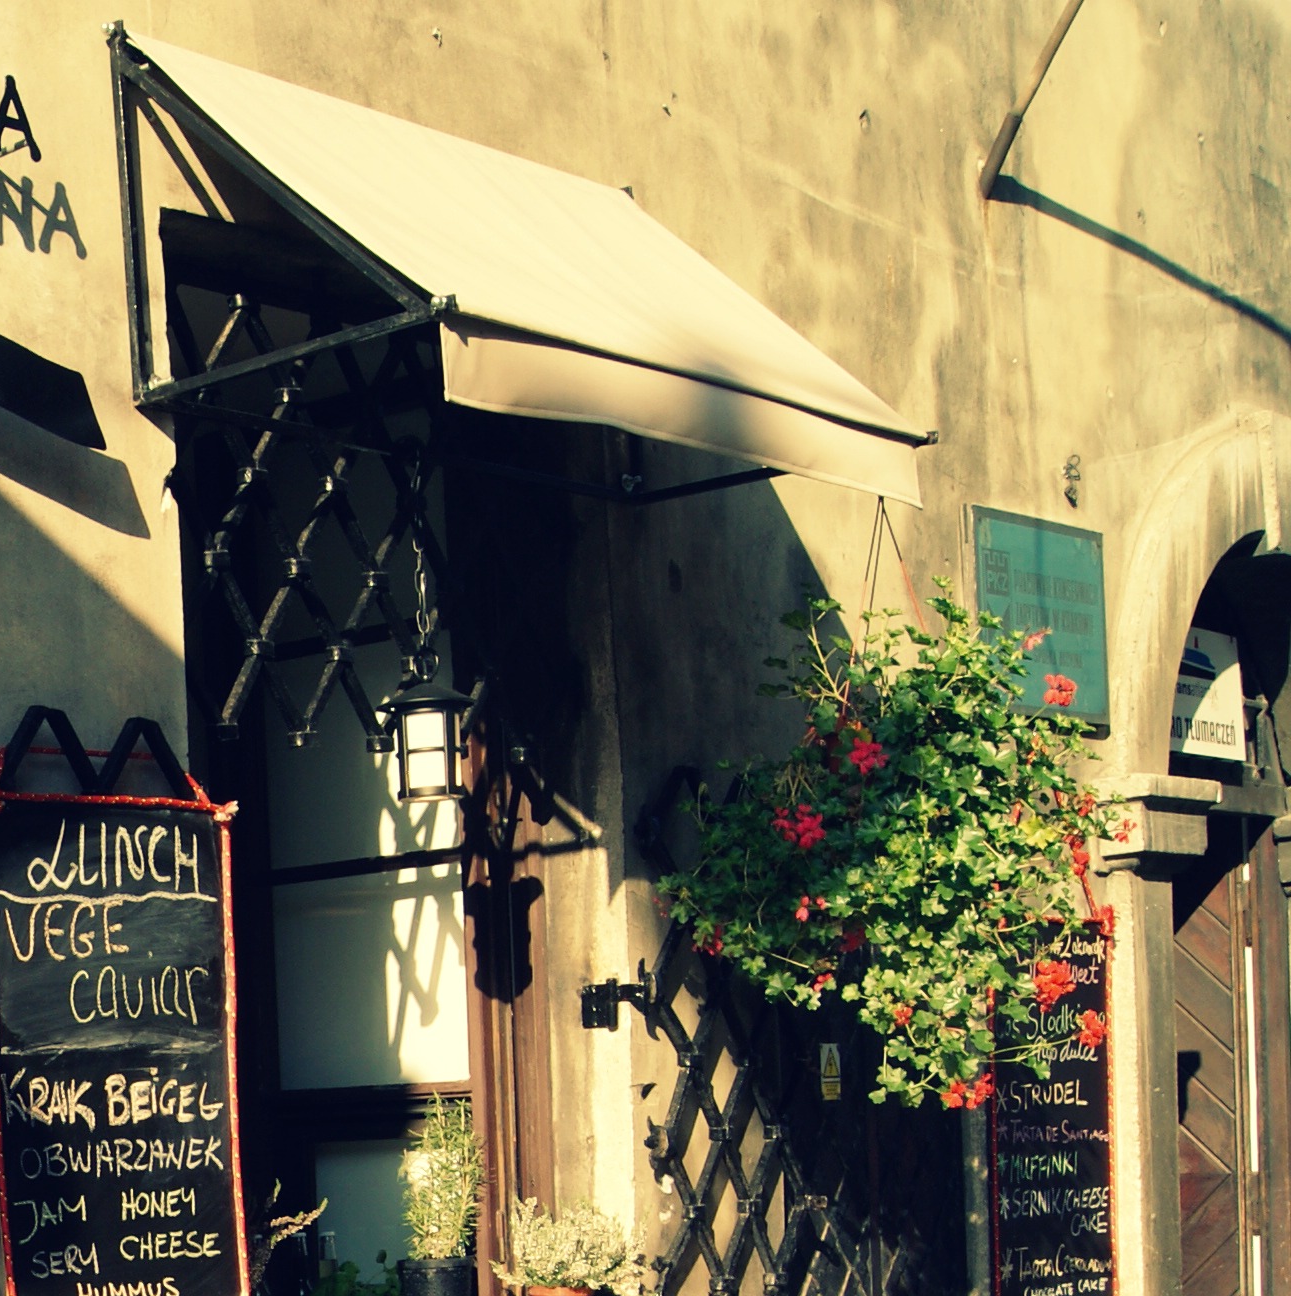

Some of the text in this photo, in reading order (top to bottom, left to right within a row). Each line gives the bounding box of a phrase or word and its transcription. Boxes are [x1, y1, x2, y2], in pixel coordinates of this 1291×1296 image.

[5, 901, 130, 962] VEGE
[0, 1067, 97, 1133] KRAK
[1010, 1079, 1089, 1114] STRUDEL
[19, 1135, 225, 1179] OBWARZANEK
[13, 1186, 196, 1245] JAM HONEY
[1071, 1210, 1108, 1237] CAKE
[31, 1230, 222, 1279] SERY CHEESE
[1078, 1276, 1109, 1293] CAKE
